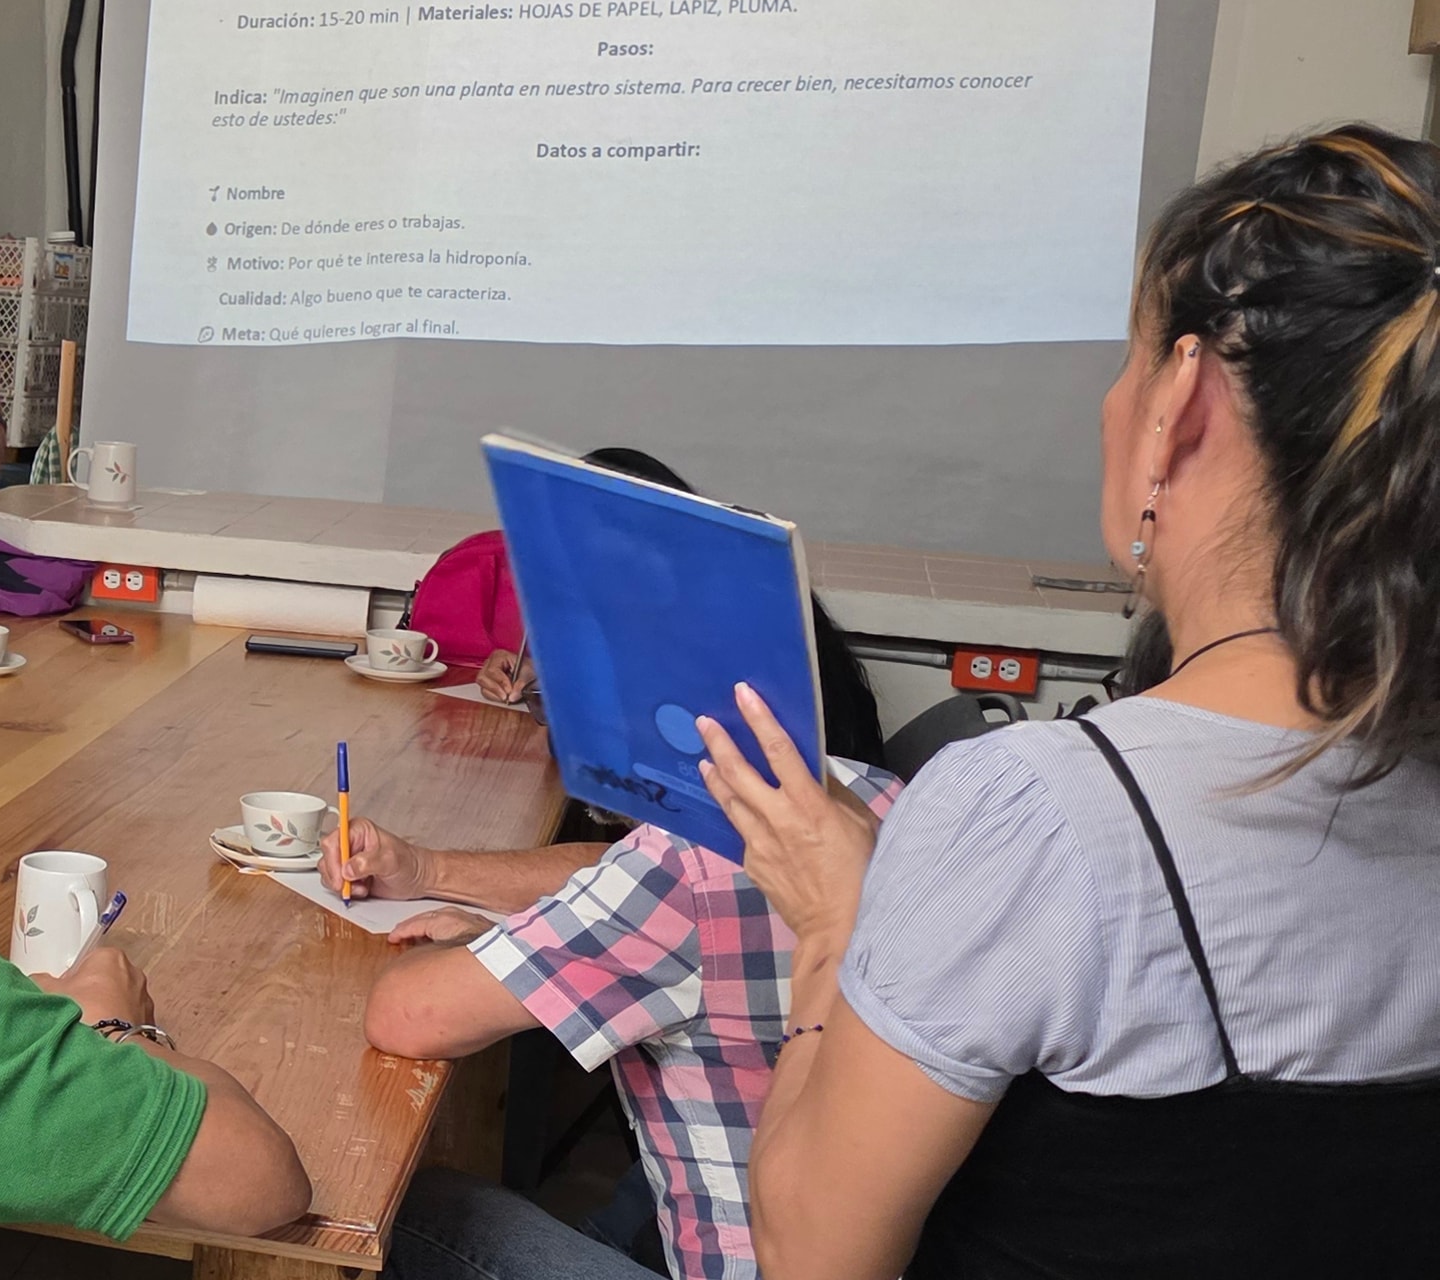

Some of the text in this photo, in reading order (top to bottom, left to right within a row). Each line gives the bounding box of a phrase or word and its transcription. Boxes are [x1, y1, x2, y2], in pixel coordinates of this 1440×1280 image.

[236, 11, 316, 31] Duración:
[318, 9, 366, 28] 15-20
[368, 7, 400, 25] min
[417, 2, 515, 23] Materiales:
[517, 1, 575, 21] HOJAS
[577, 1, 603, 19] DE
[606, 0, 665, 19] PAPEL,
[596, 40, 655, 58] Pasos:
[213, 87, 269, 106] Indica:
[357, 87, 389, 105] que
[390, 84, 421, 100] son
[423, 83, 457, 98] una
[458, 79, 516, 102] planta
[517, 83, 541, 97] en
[543, 80, 611, 97] nuestro
[612, 77, 687, 97] sistema.
[689, 77, 734, 95] Para
[735, 79, 793, 94] crecer
[793, 73, 838, 95] bien,
[842, 72, 957, 92] necesitamos
[958, 74, 1035, 90] conocer
[211, 111, 247, 128] esto
[247, 109, 270, 128] de
[535, 139, 702, 163] Datos a compartir:
[225, 184, 286, 202] Nombre
[223, 212, 466, 240] Origen: De dónde eres o trabajas.
[226, 247, 533, 273] Motivo: Por qué te interesa la hidroponía.
[217, 285, 512, 309] Cualidad: Algo bueno que te caracteriza.
[221, 317, 460, 343] Meta: Qué quieres lograr al final.
